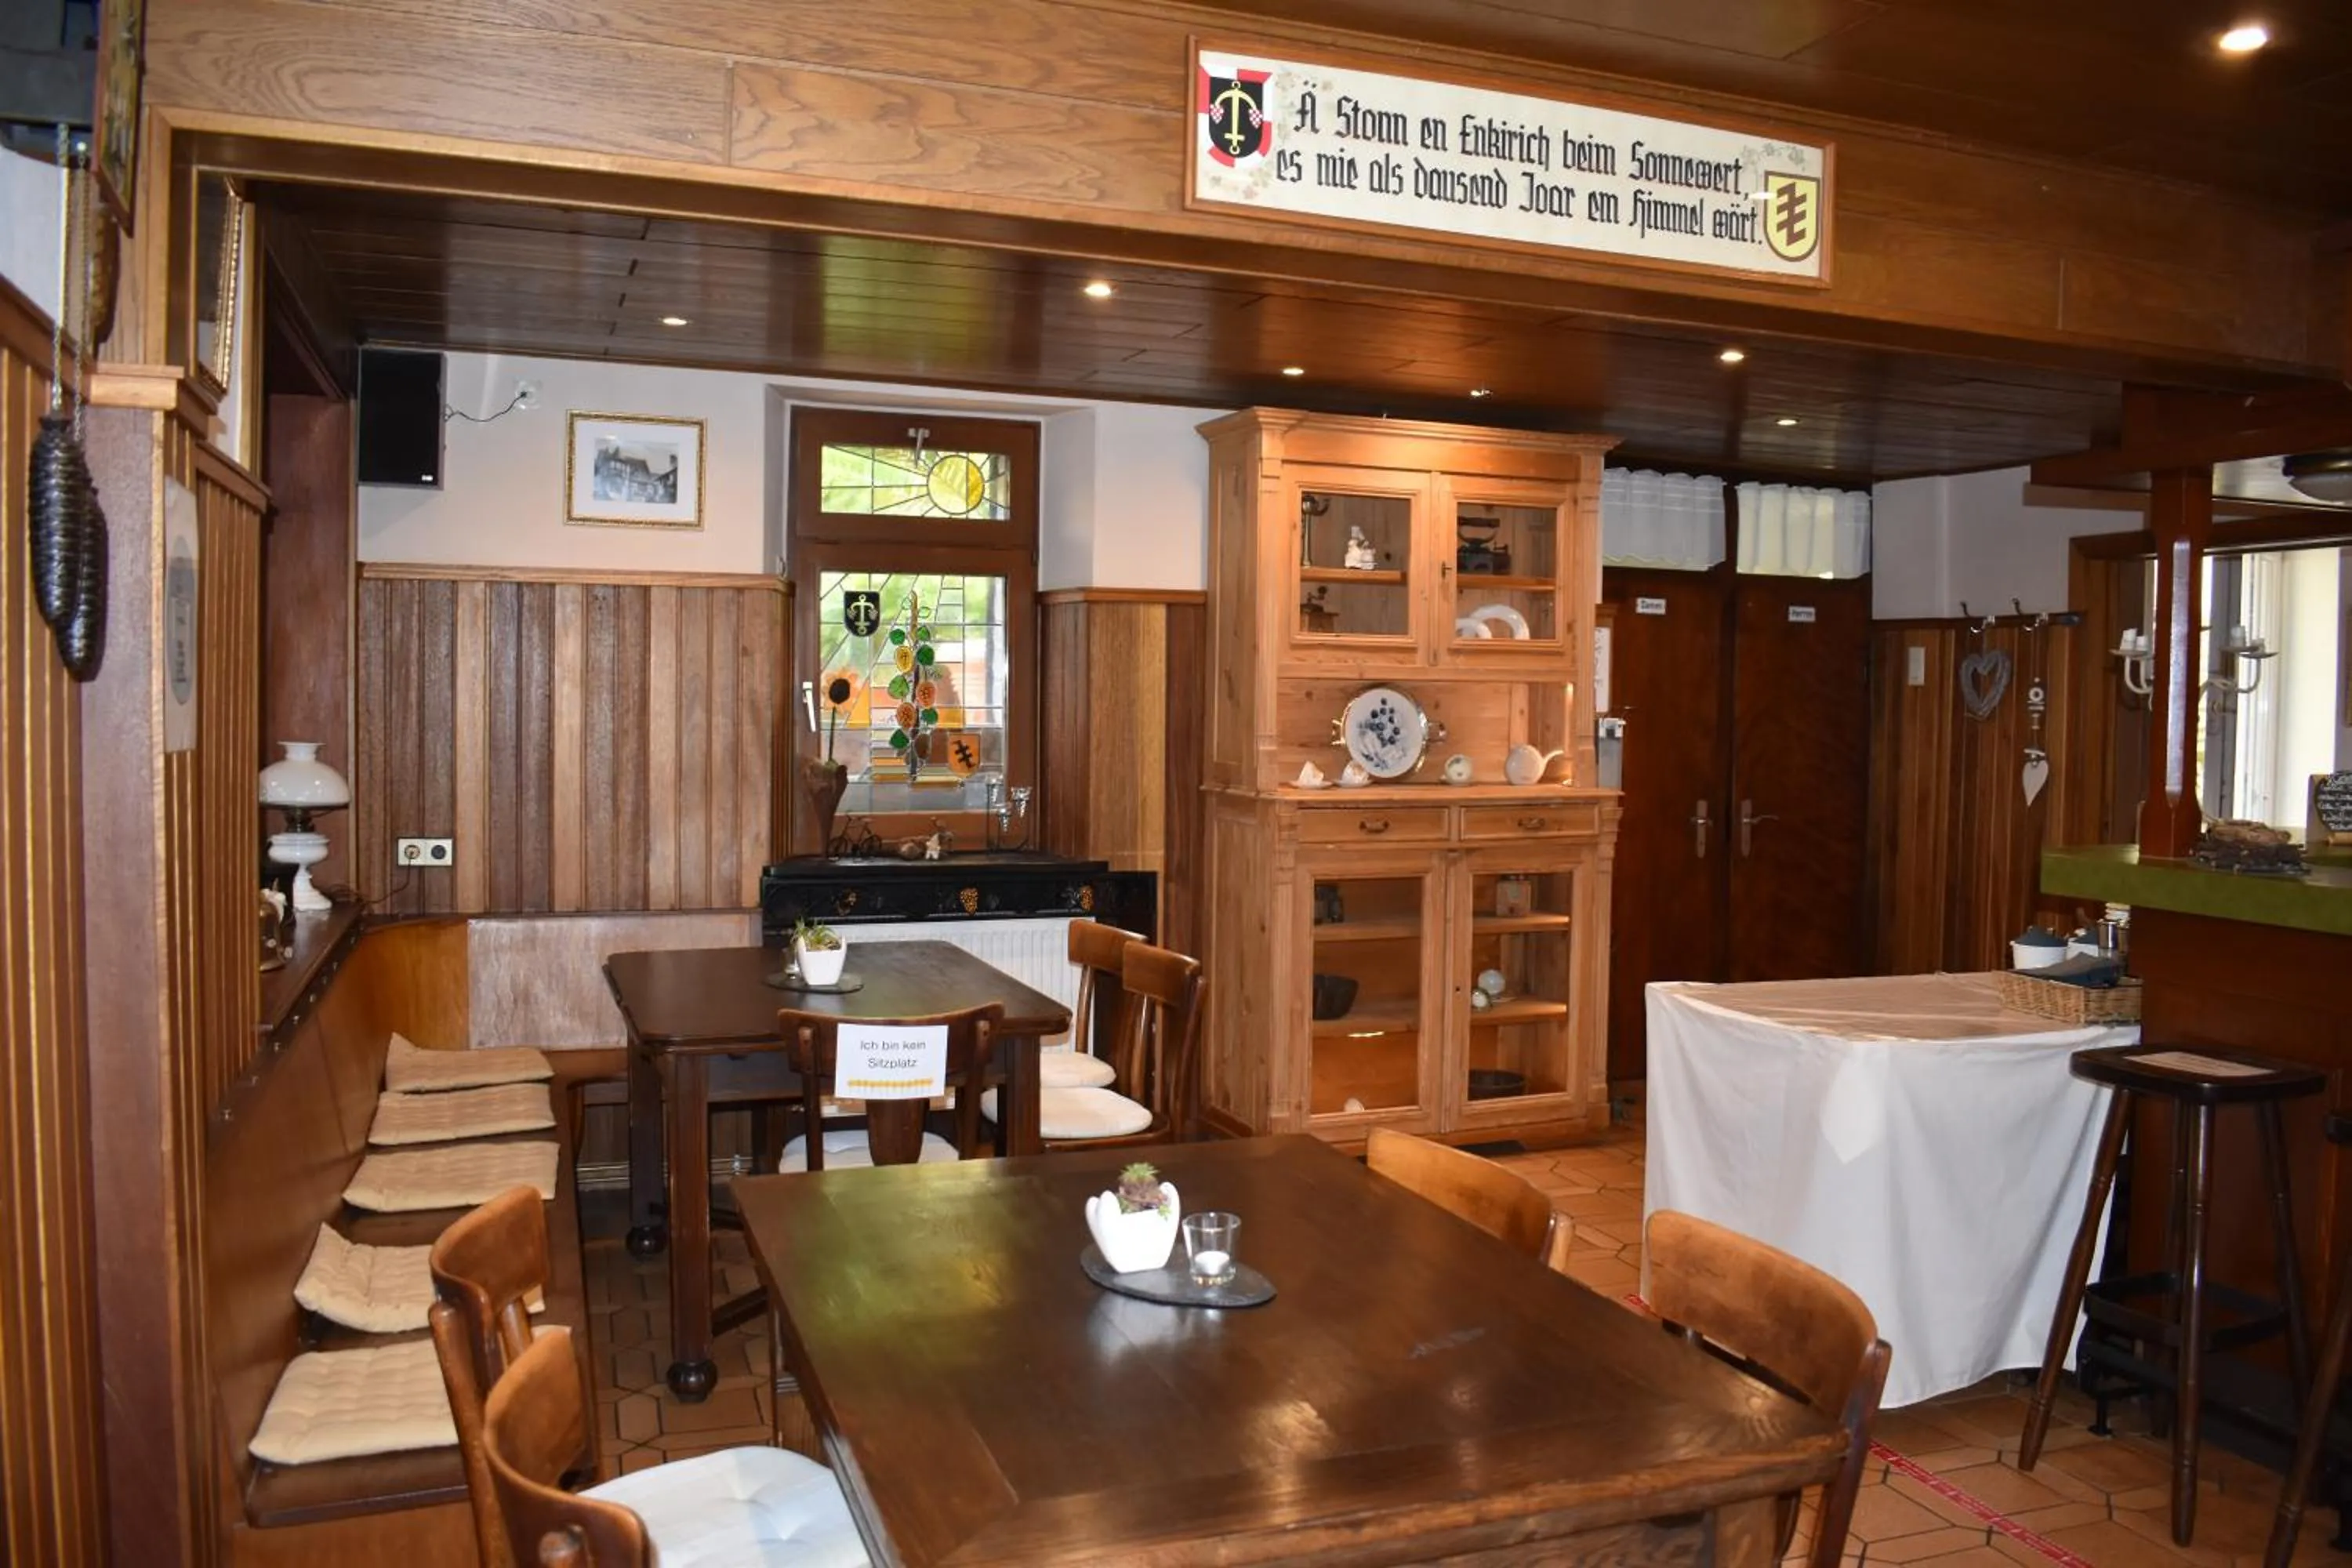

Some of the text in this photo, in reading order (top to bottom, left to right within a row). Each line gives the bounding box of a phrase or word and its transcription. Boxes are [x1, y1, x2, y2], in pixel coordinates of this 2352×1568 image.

[1294, 80, 1749, 201] Ä Stonn en Enkirich beim Sonnewert,
[1276, 148, 1303, 183] es
[1369, 153, 1404, 196] als
[1413, 156, 1508, 209] dausend
[1518, 171, 1576, 218] Joar
[1588, 190, 1621, 224] em
[1628, 188, 1704, 239] Himmel
[1711, 201, 1763, 245] wärt.
[860, 1040, 927, 1051] Ich bin kein
[867, 1058, 917, 1069] Sitzplatz
